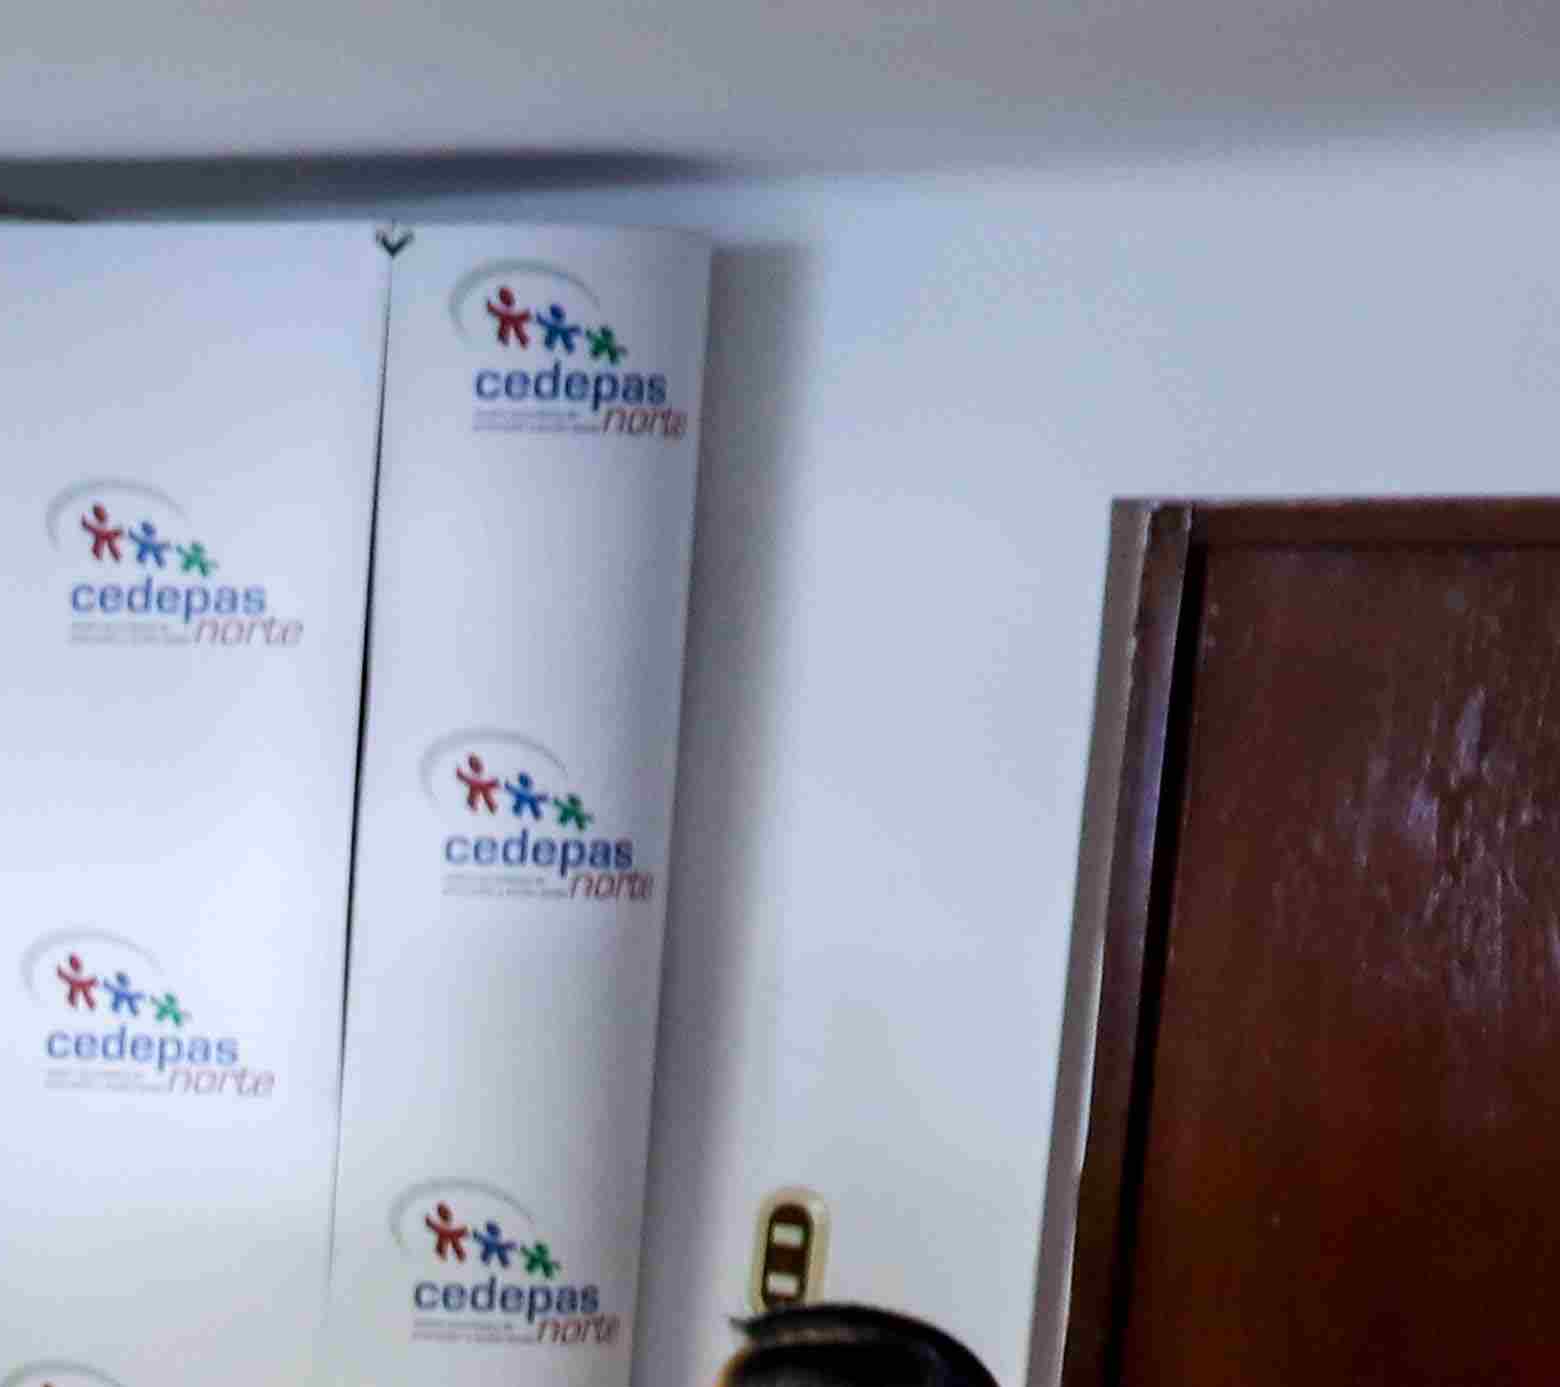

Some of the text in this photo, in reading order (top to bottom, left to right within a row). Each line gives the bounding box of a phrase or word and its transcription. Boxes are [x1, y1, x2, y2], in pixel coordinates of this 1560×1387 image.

[475, 364, 668, 410] cedepas
[70, 577, 266, 622] cedepas
[194, 611, 304, 648] norte
[445, 831, 634, 877] cedepas
[46, 1027, 239, 1071] cedepas
[167, 1062, 274, 1098] norte
[414, 1277, 600, 1320] cedepas
